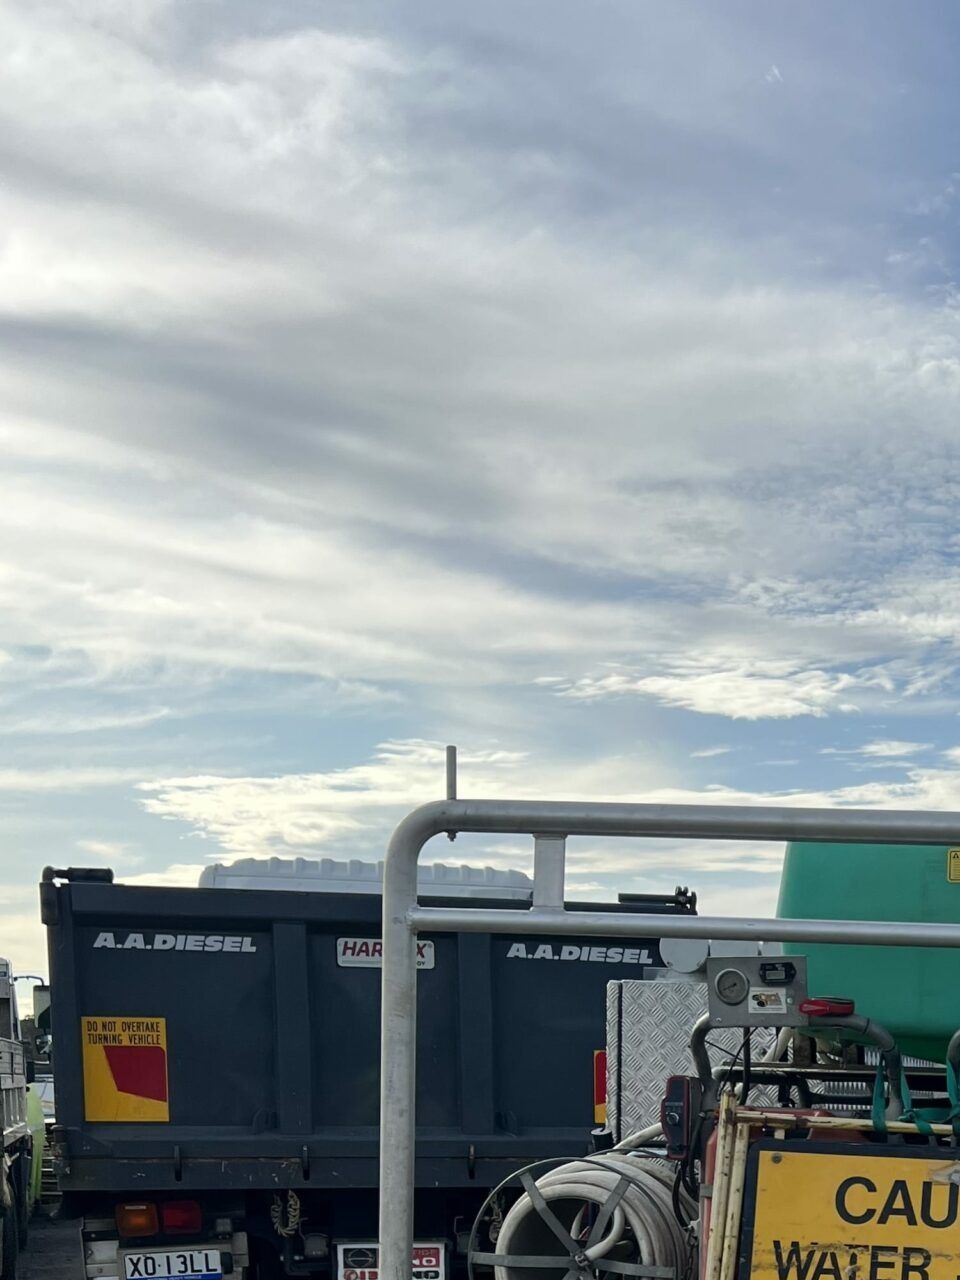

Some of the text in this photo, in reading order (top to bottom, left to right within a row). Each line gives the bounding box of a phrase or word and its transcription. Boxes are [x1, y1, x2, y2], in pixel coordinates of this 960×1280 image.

[93, 932, 257, 952] A.A.DIESEL
[342, 941, 429, 961] HARX
[506, 943, 653, 964] A.A.DIESEL
[87, 1021, 161, 1033] DO NOT OVERTAKE
[87, 1033, 161, 1045] TURNING VEHICLE
